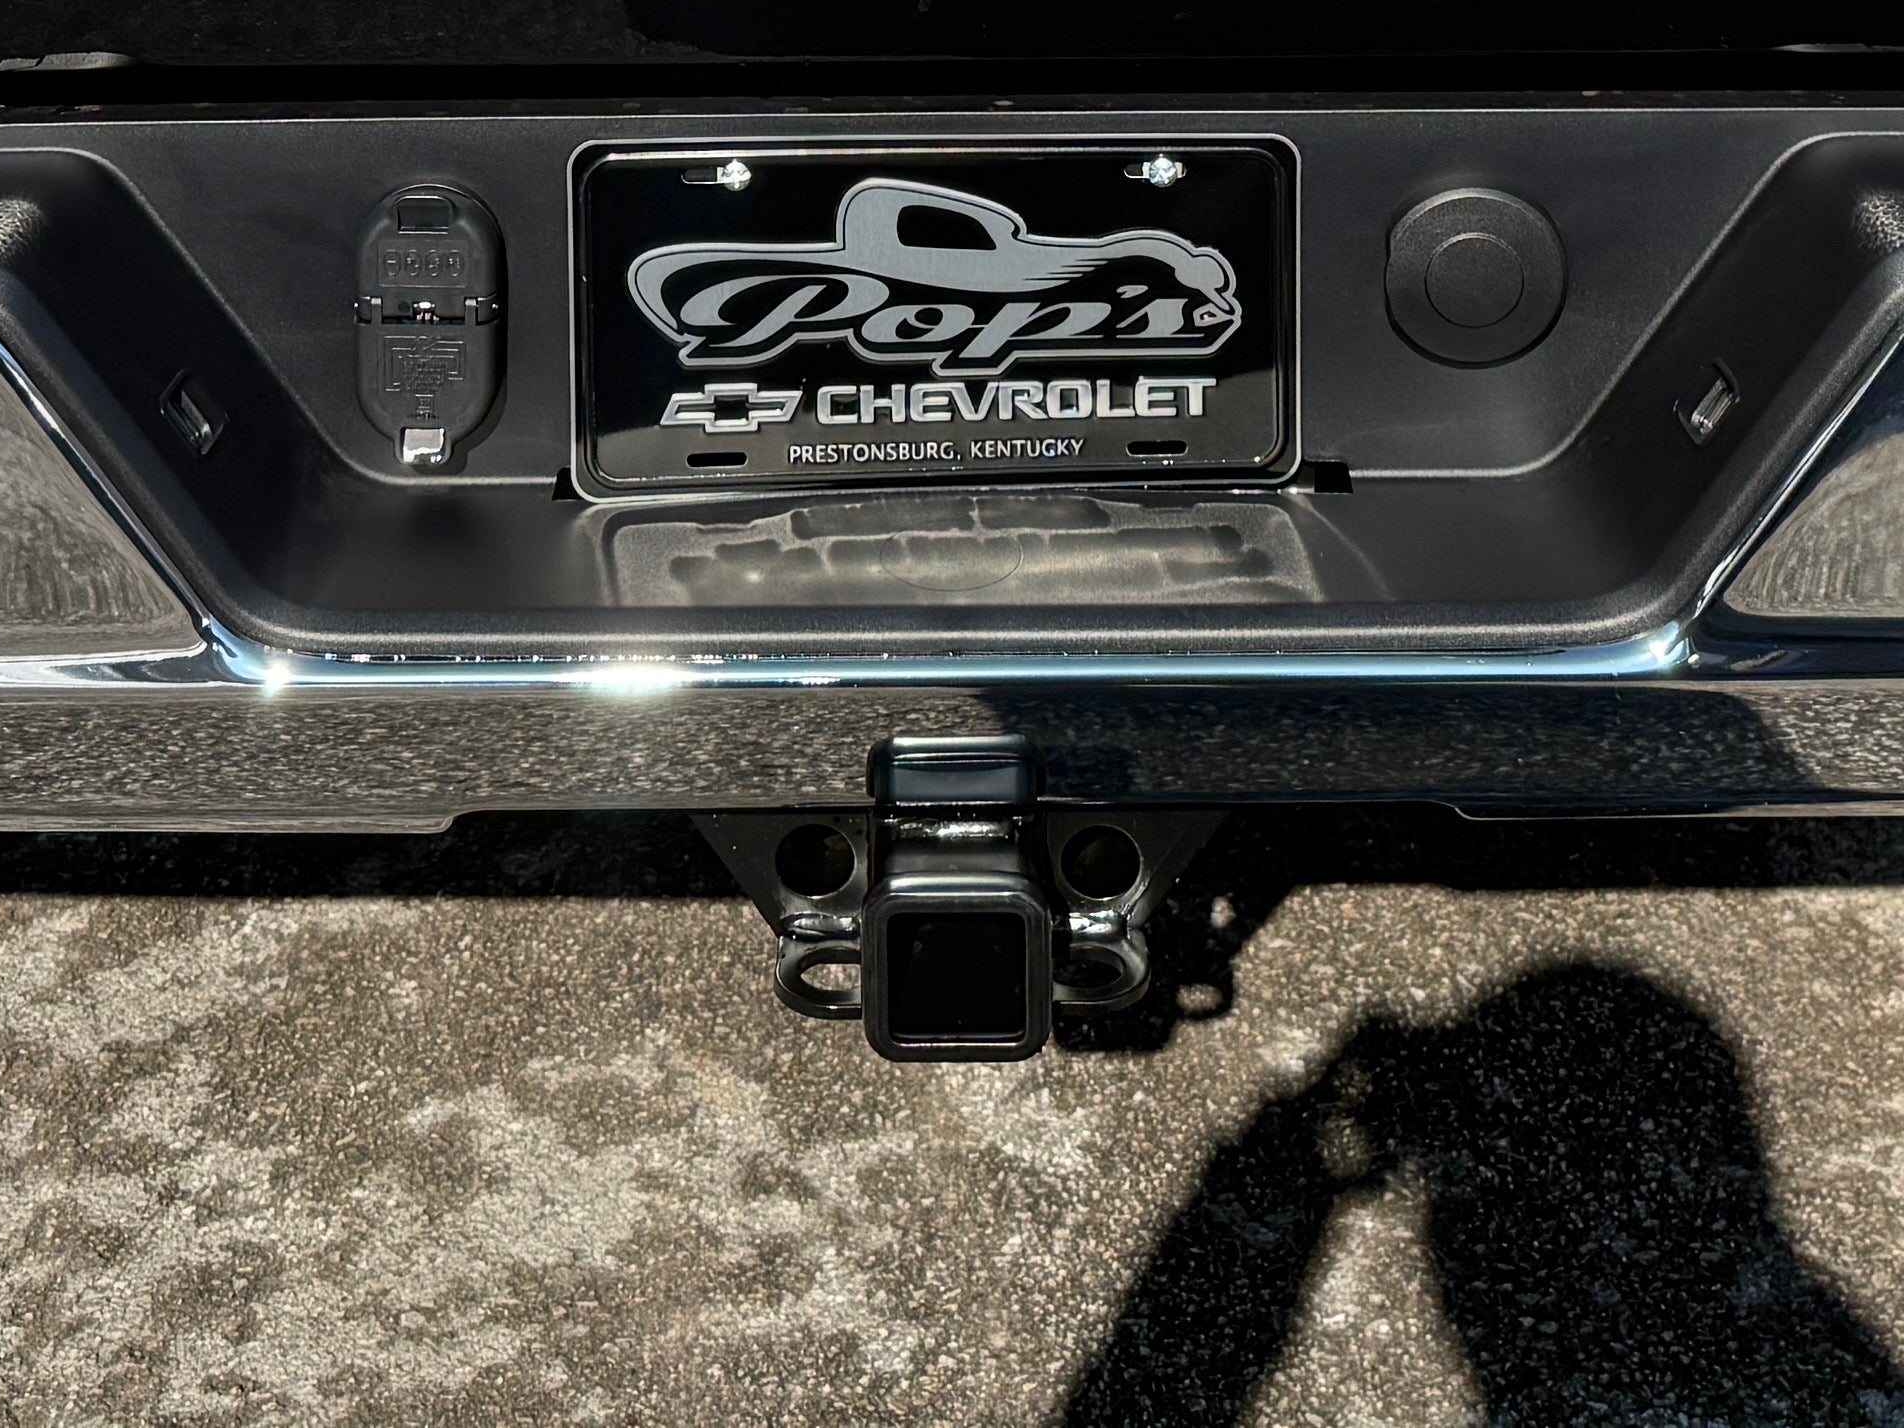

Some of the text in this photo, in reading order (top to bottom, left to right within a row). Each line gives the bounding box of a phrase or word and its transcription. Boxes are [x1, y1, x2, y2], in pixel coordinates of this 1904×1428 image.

[679, 273, 1202, 359] Pop's
[816, 376, 1217, 426] CHEVROLET
[787, 437, 1085, 465] PRESTONSBURG, KENTUCKY
